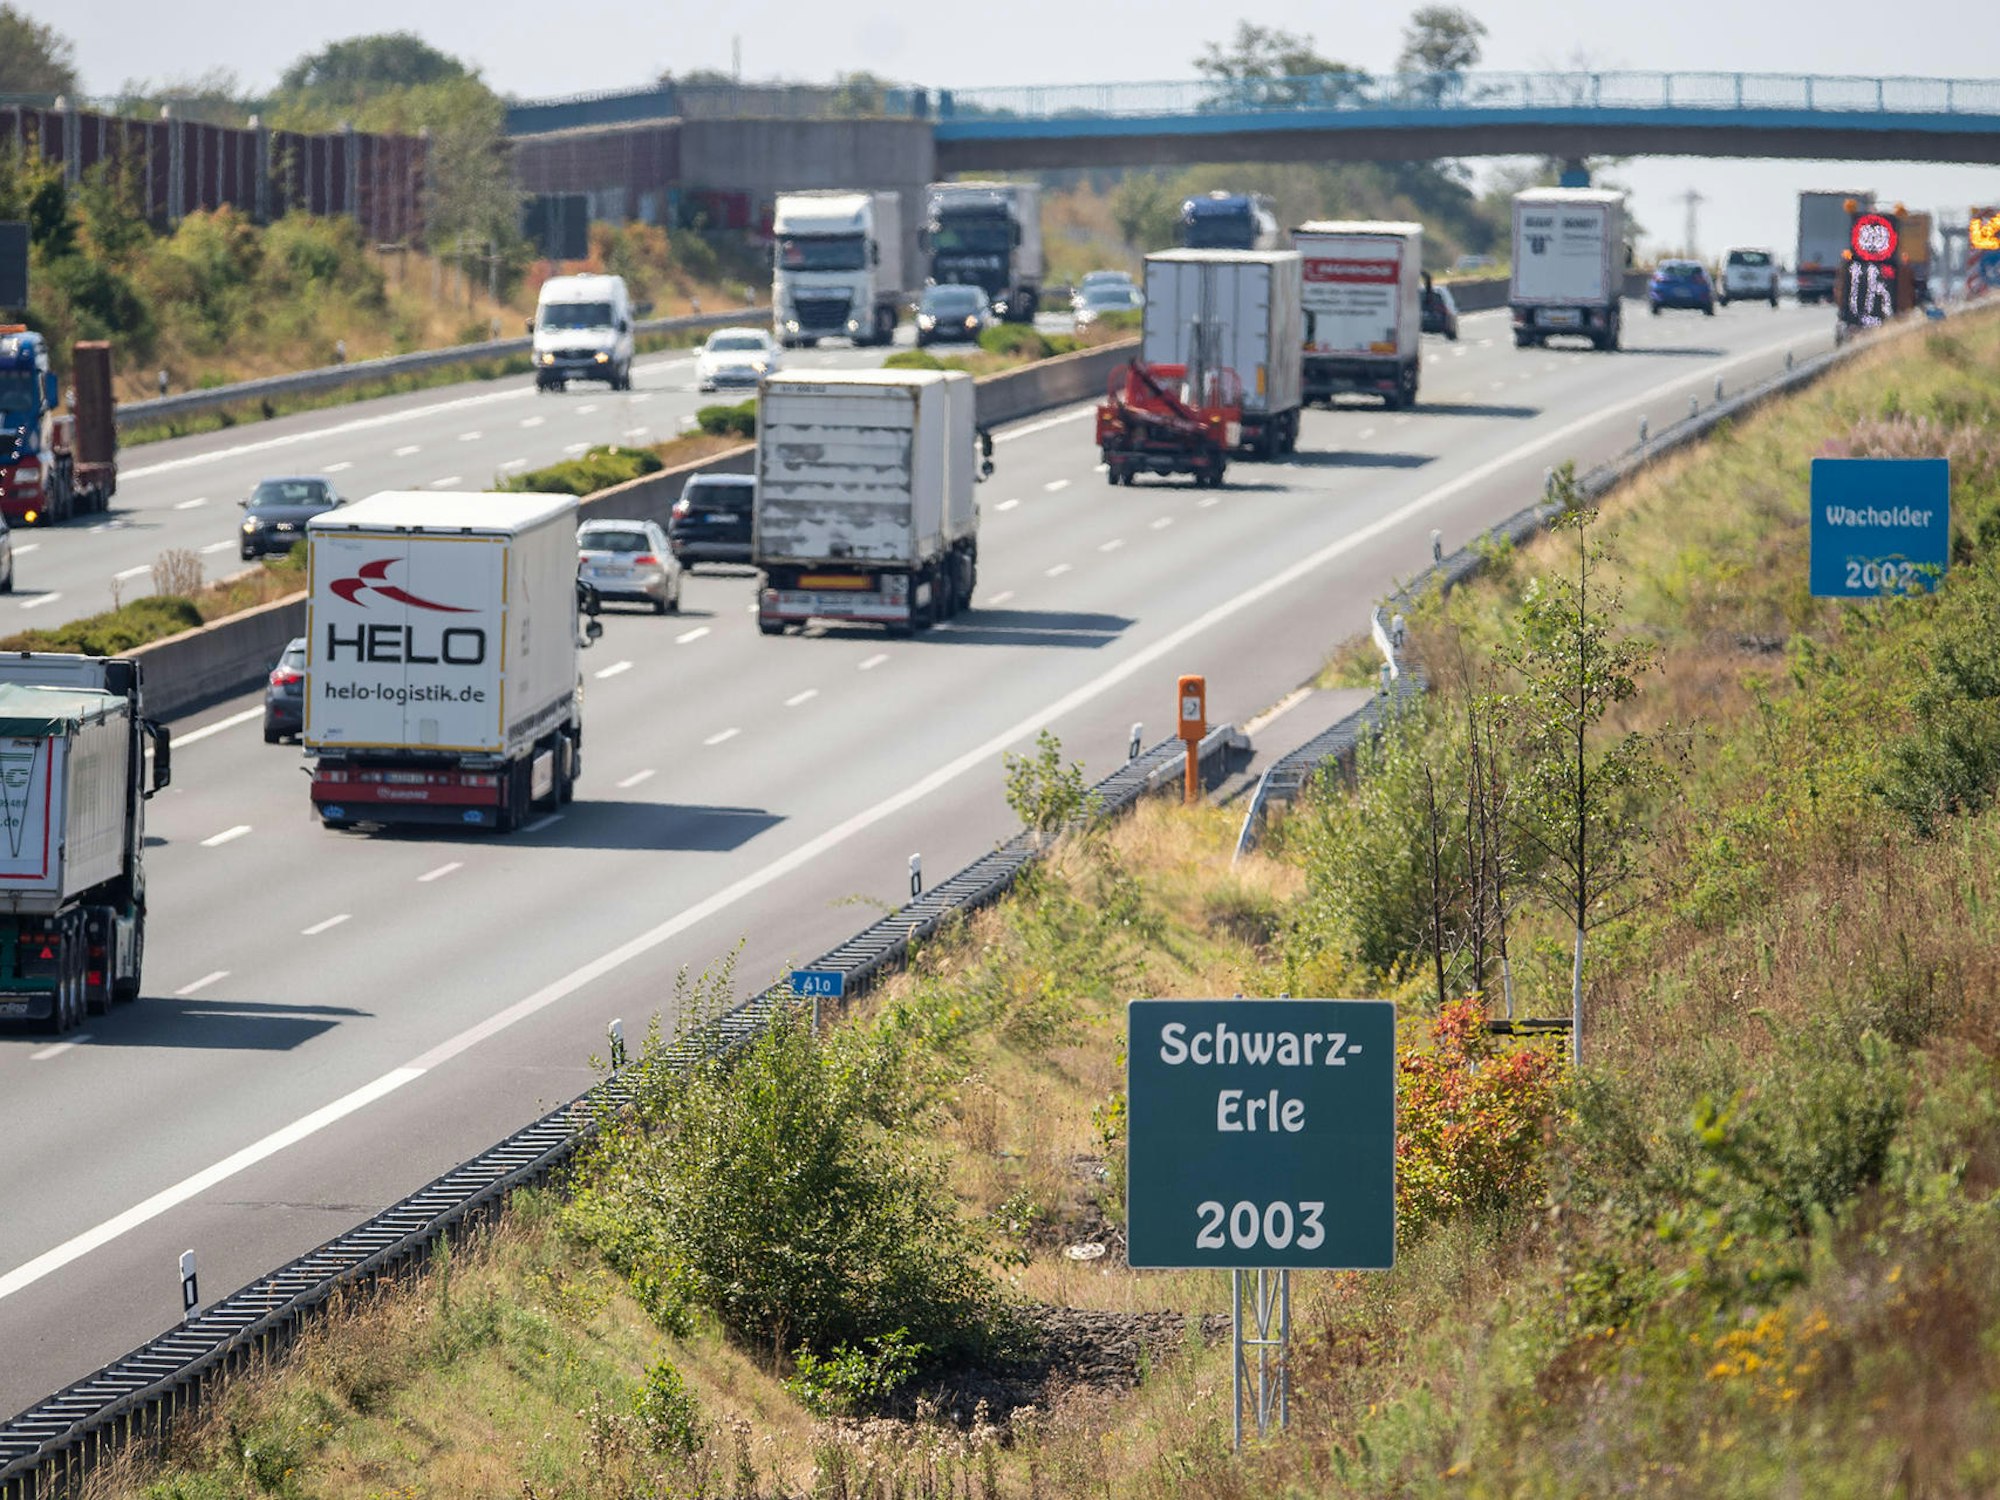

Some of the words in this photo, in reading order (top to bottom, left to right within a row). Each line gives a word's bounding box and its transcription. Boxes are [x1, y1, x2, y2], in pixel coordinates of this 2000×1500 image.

[1826, 505, 1933, 527] Wacholder
[1845, 562, 1914, 589] 2002
[327, 623, 486, 665] HELO
[325, 682, 485, 705] helo-logistik.de
[1160, 1022, 1363, 1066] Schwarz-
[1217, 1089, 1305, 1132] Erle
[1196, 1201, 1326, 1249] 2003
